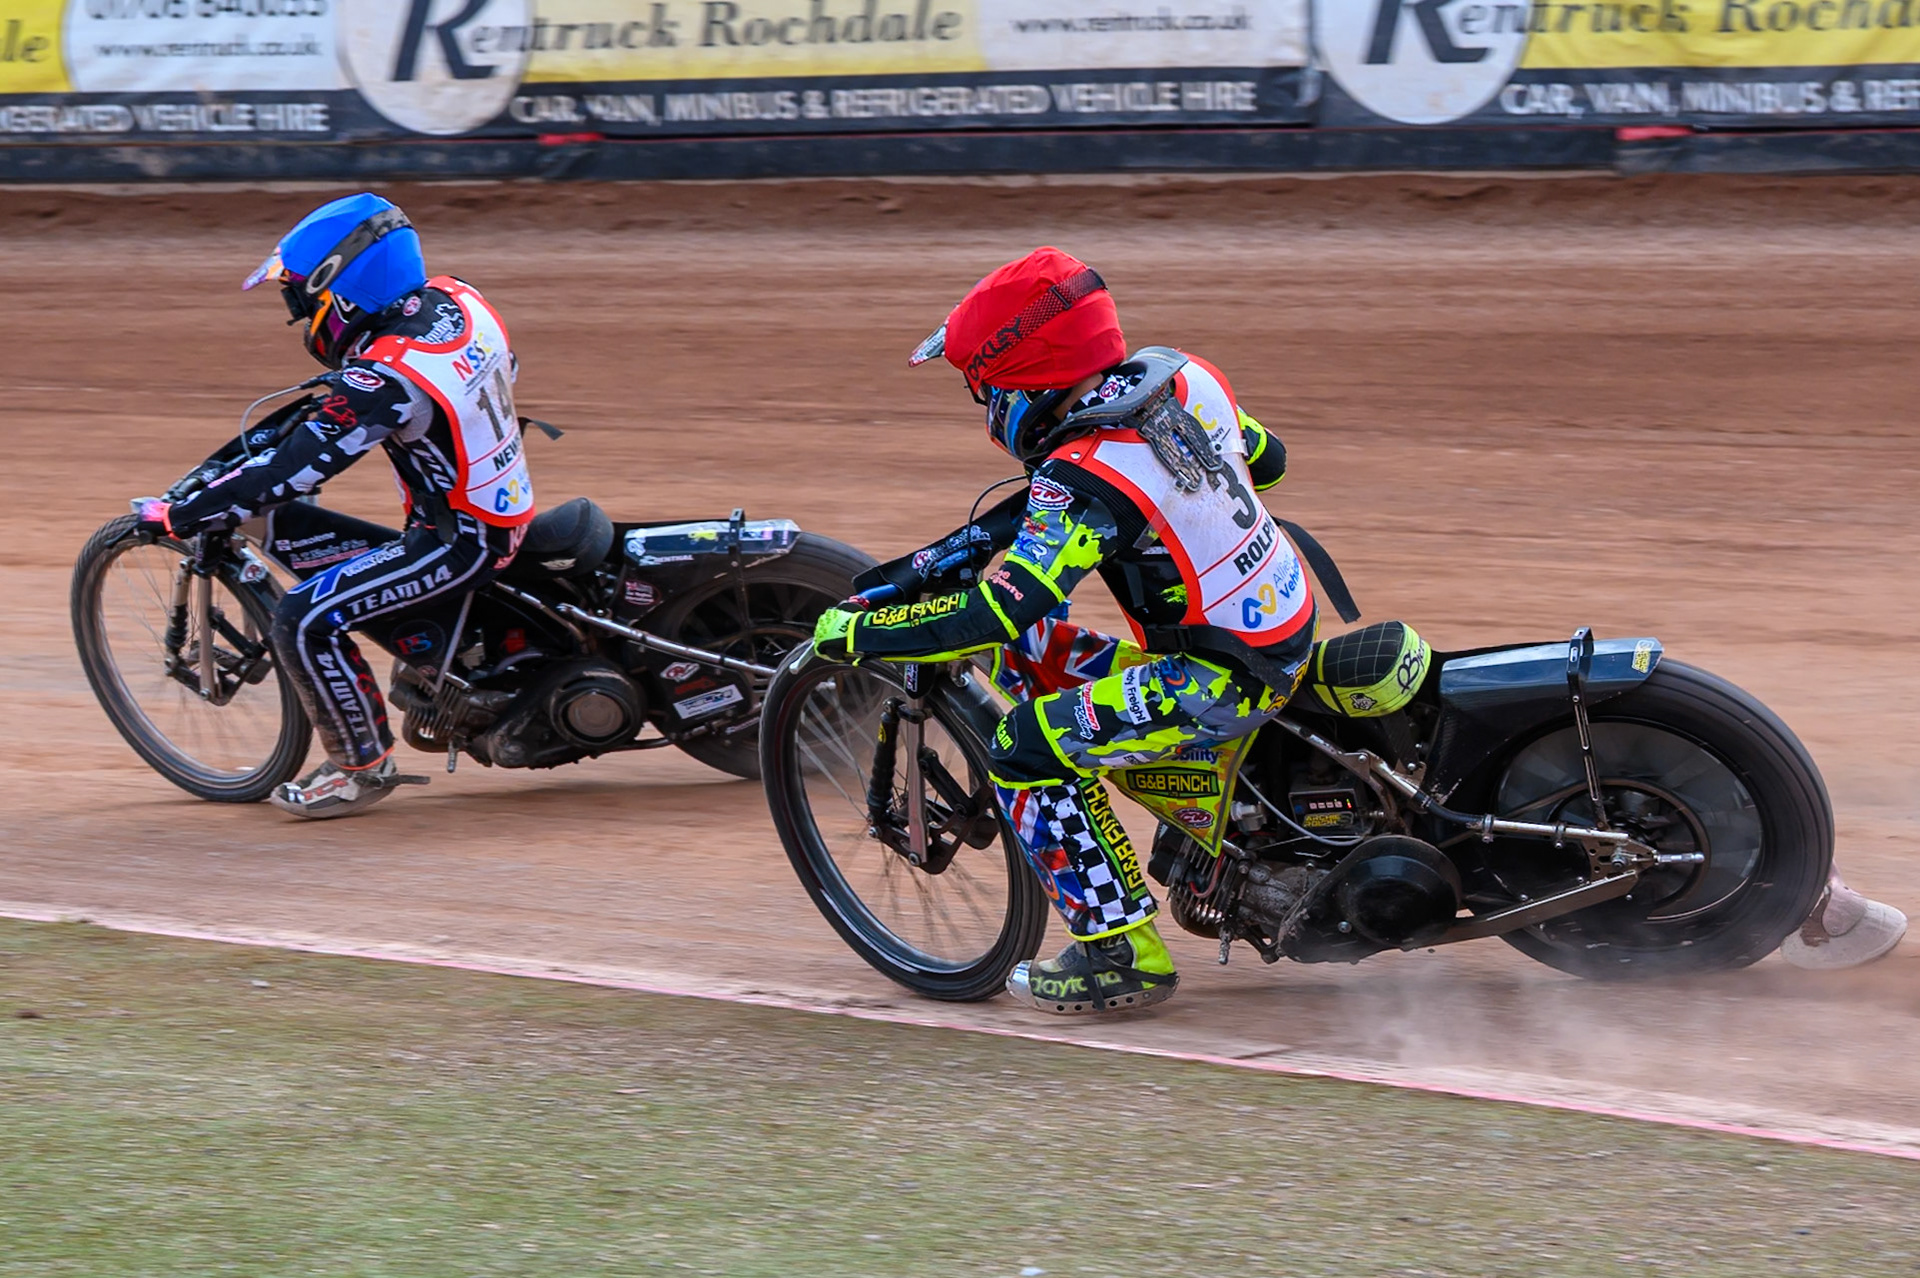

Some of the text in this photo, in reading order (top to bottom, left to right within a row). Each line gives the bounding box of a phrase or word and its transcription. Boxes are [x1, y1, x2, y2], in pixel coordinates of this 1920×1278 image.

[698, 0, 963, 46] Rochdale
[802, 89, 831, 119] &
[831, 84, 1051, 119] REFRIGERATED
[1050, 82, 1181, 113] VEHICLE
[1181, 82, 1258, 112] HIRE
[1830, 81, 1863, 111] &
[966, 316, 1021, 382] OAKLEY
[1206, 458, 1258, 530] 3
[346, 564, 453, 616] TEAM 14
[910, 592, 960, 619] FINCH
[1127, 686, 1147, 722] Freight
[1135, 773, 1211, 793] G&B FINCH
